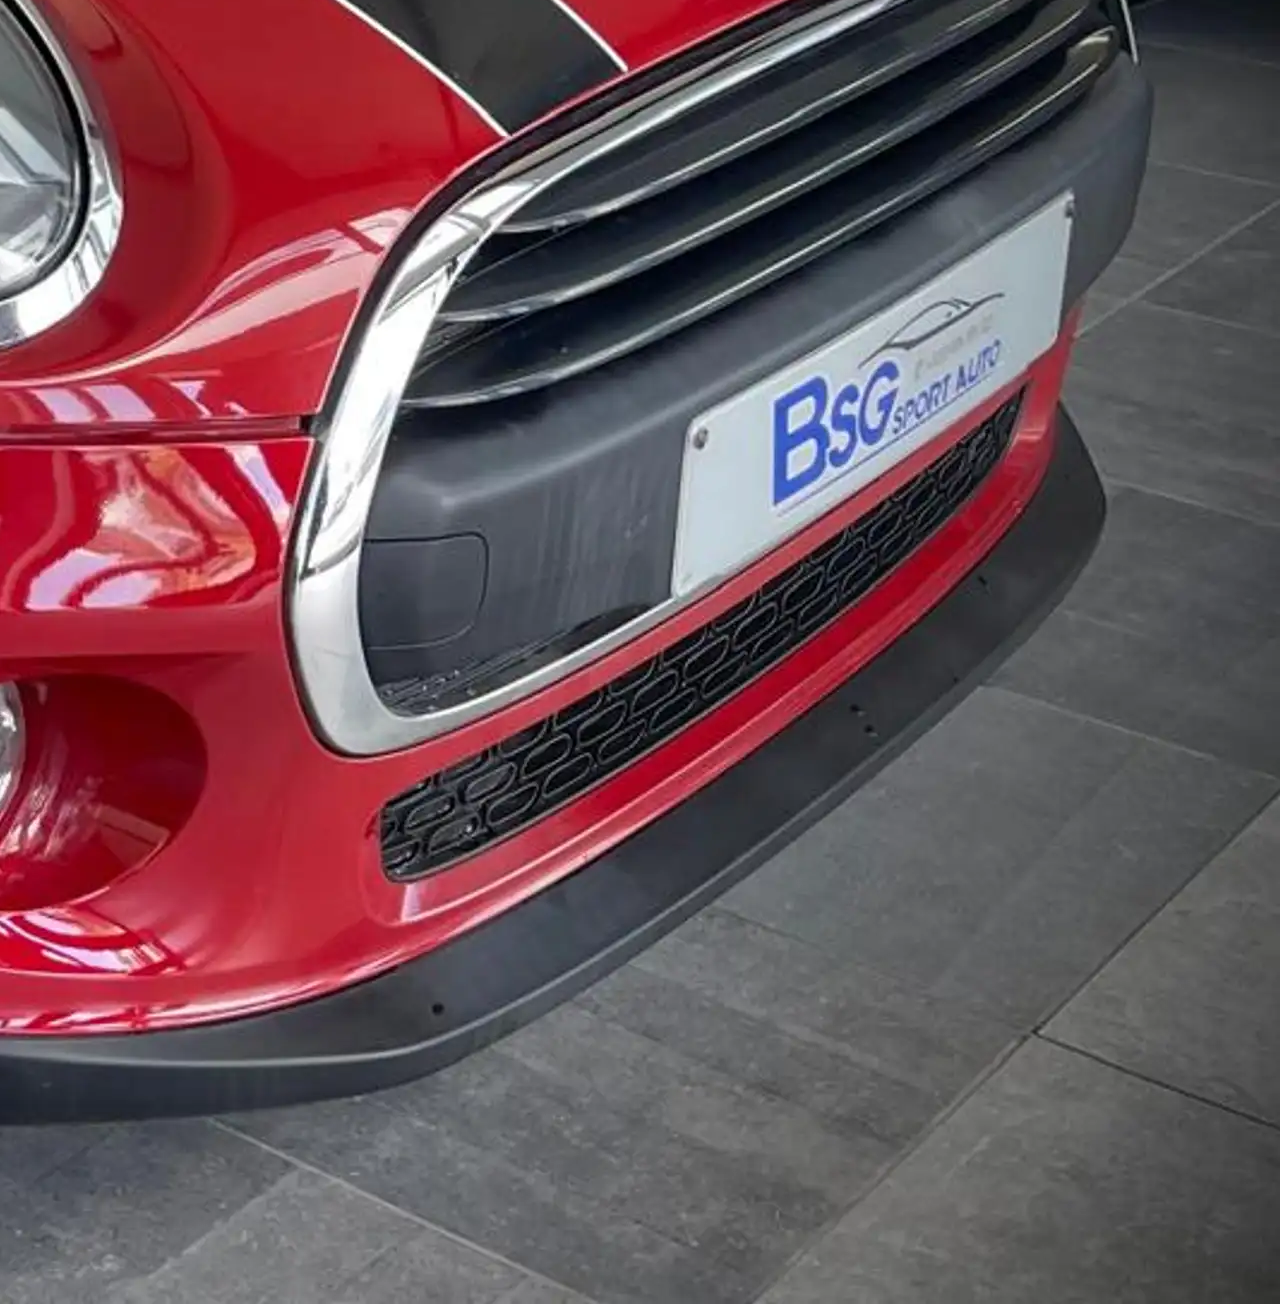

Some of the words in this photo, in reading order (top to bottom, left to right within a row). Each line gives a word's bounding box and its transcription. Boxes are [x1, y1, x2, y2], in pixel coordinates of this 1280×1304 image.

[773, 360, 899, 507] BSG
[893, 375, 951, 434] SPORT
[956, 340, 1002, 393] AUTO
